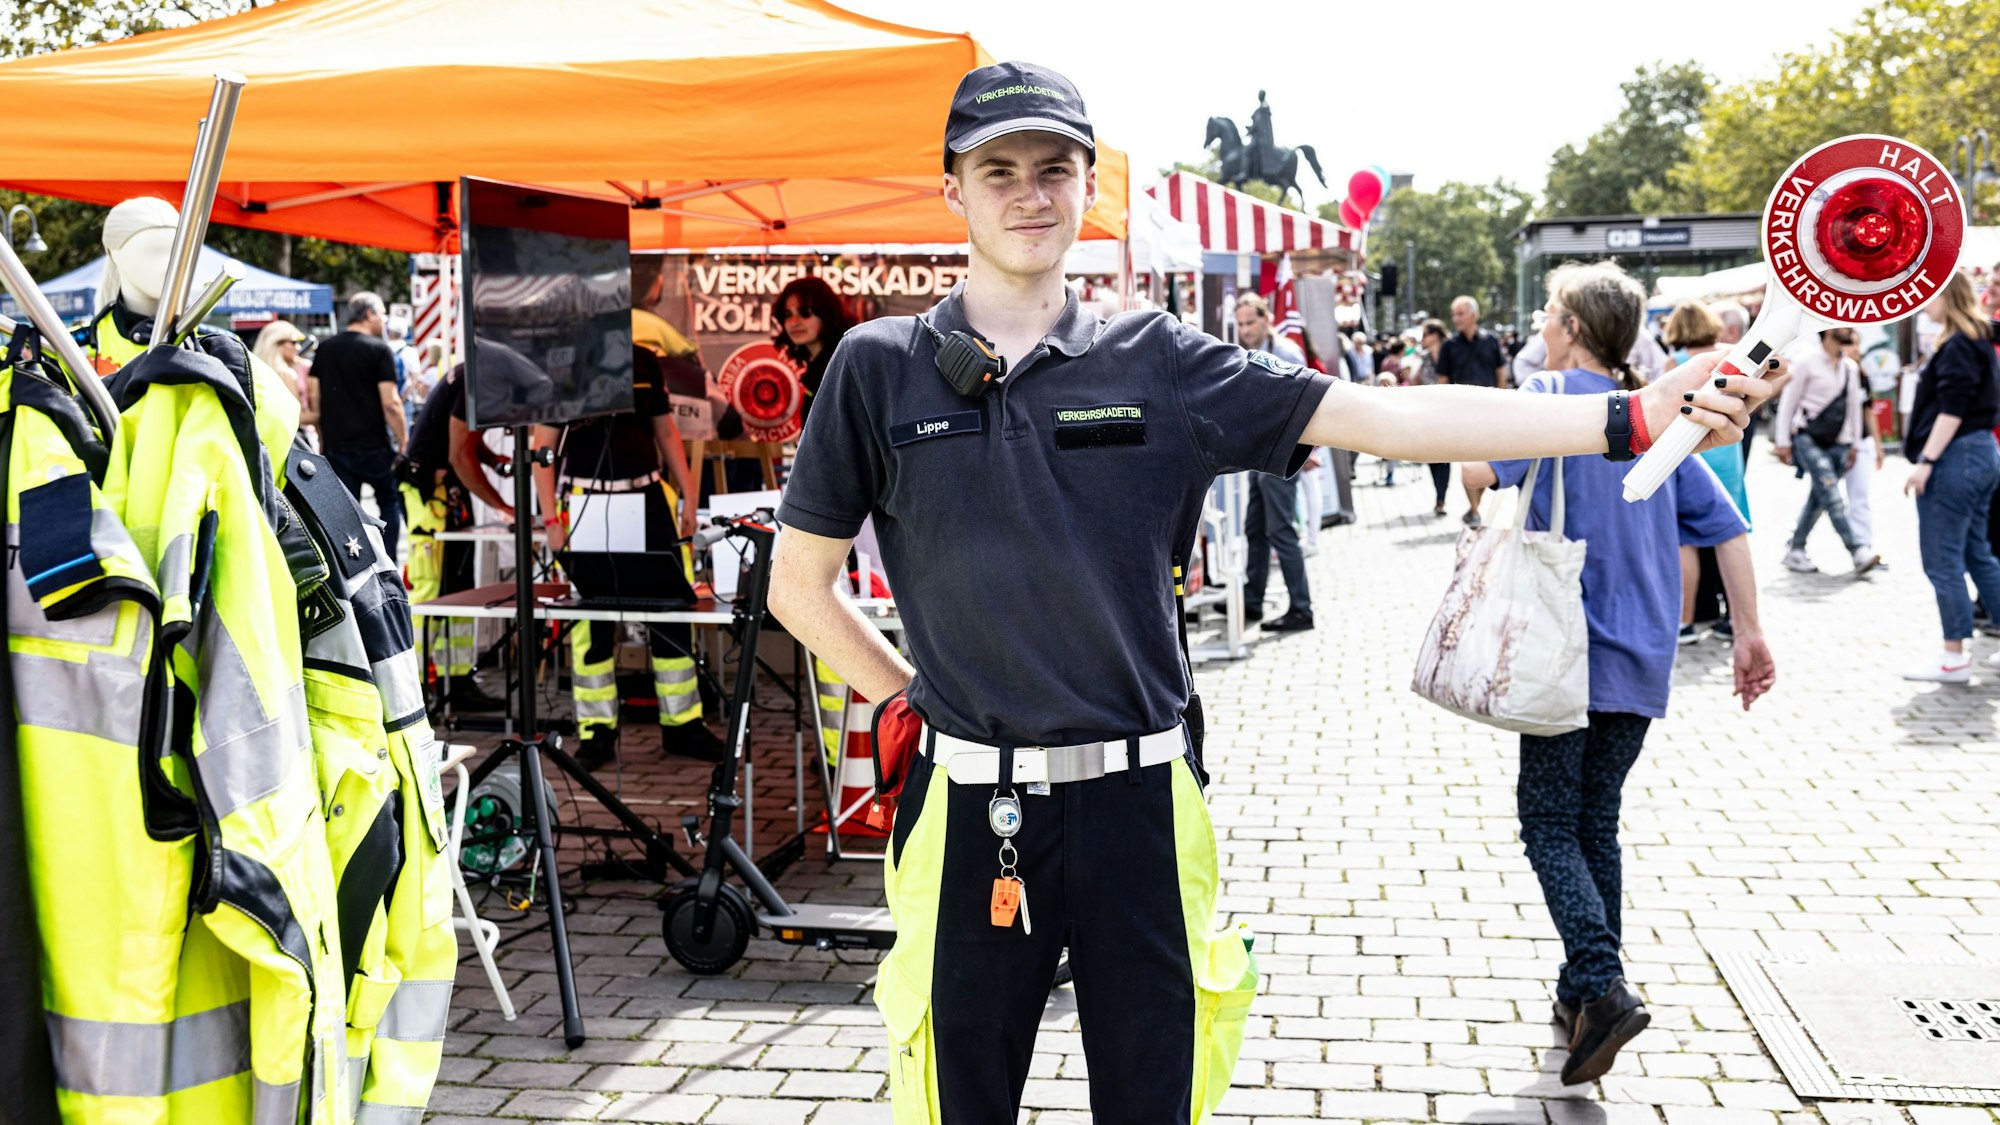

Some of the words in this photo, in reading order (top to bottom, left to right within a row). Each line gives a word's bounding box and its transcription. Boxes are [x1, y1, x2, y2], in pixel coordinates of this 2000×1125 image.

[976, 85, 1066, 104] VERKEHRSKADETTEN
[1879, 145, 1954, 205] HALT
[1770, 176, 1936, 320] VERKEHRSWACHT
[1057, 407, 1141, 421] VERKEHRSKADETTEN
[916, 420, 949, 434] Lippe
